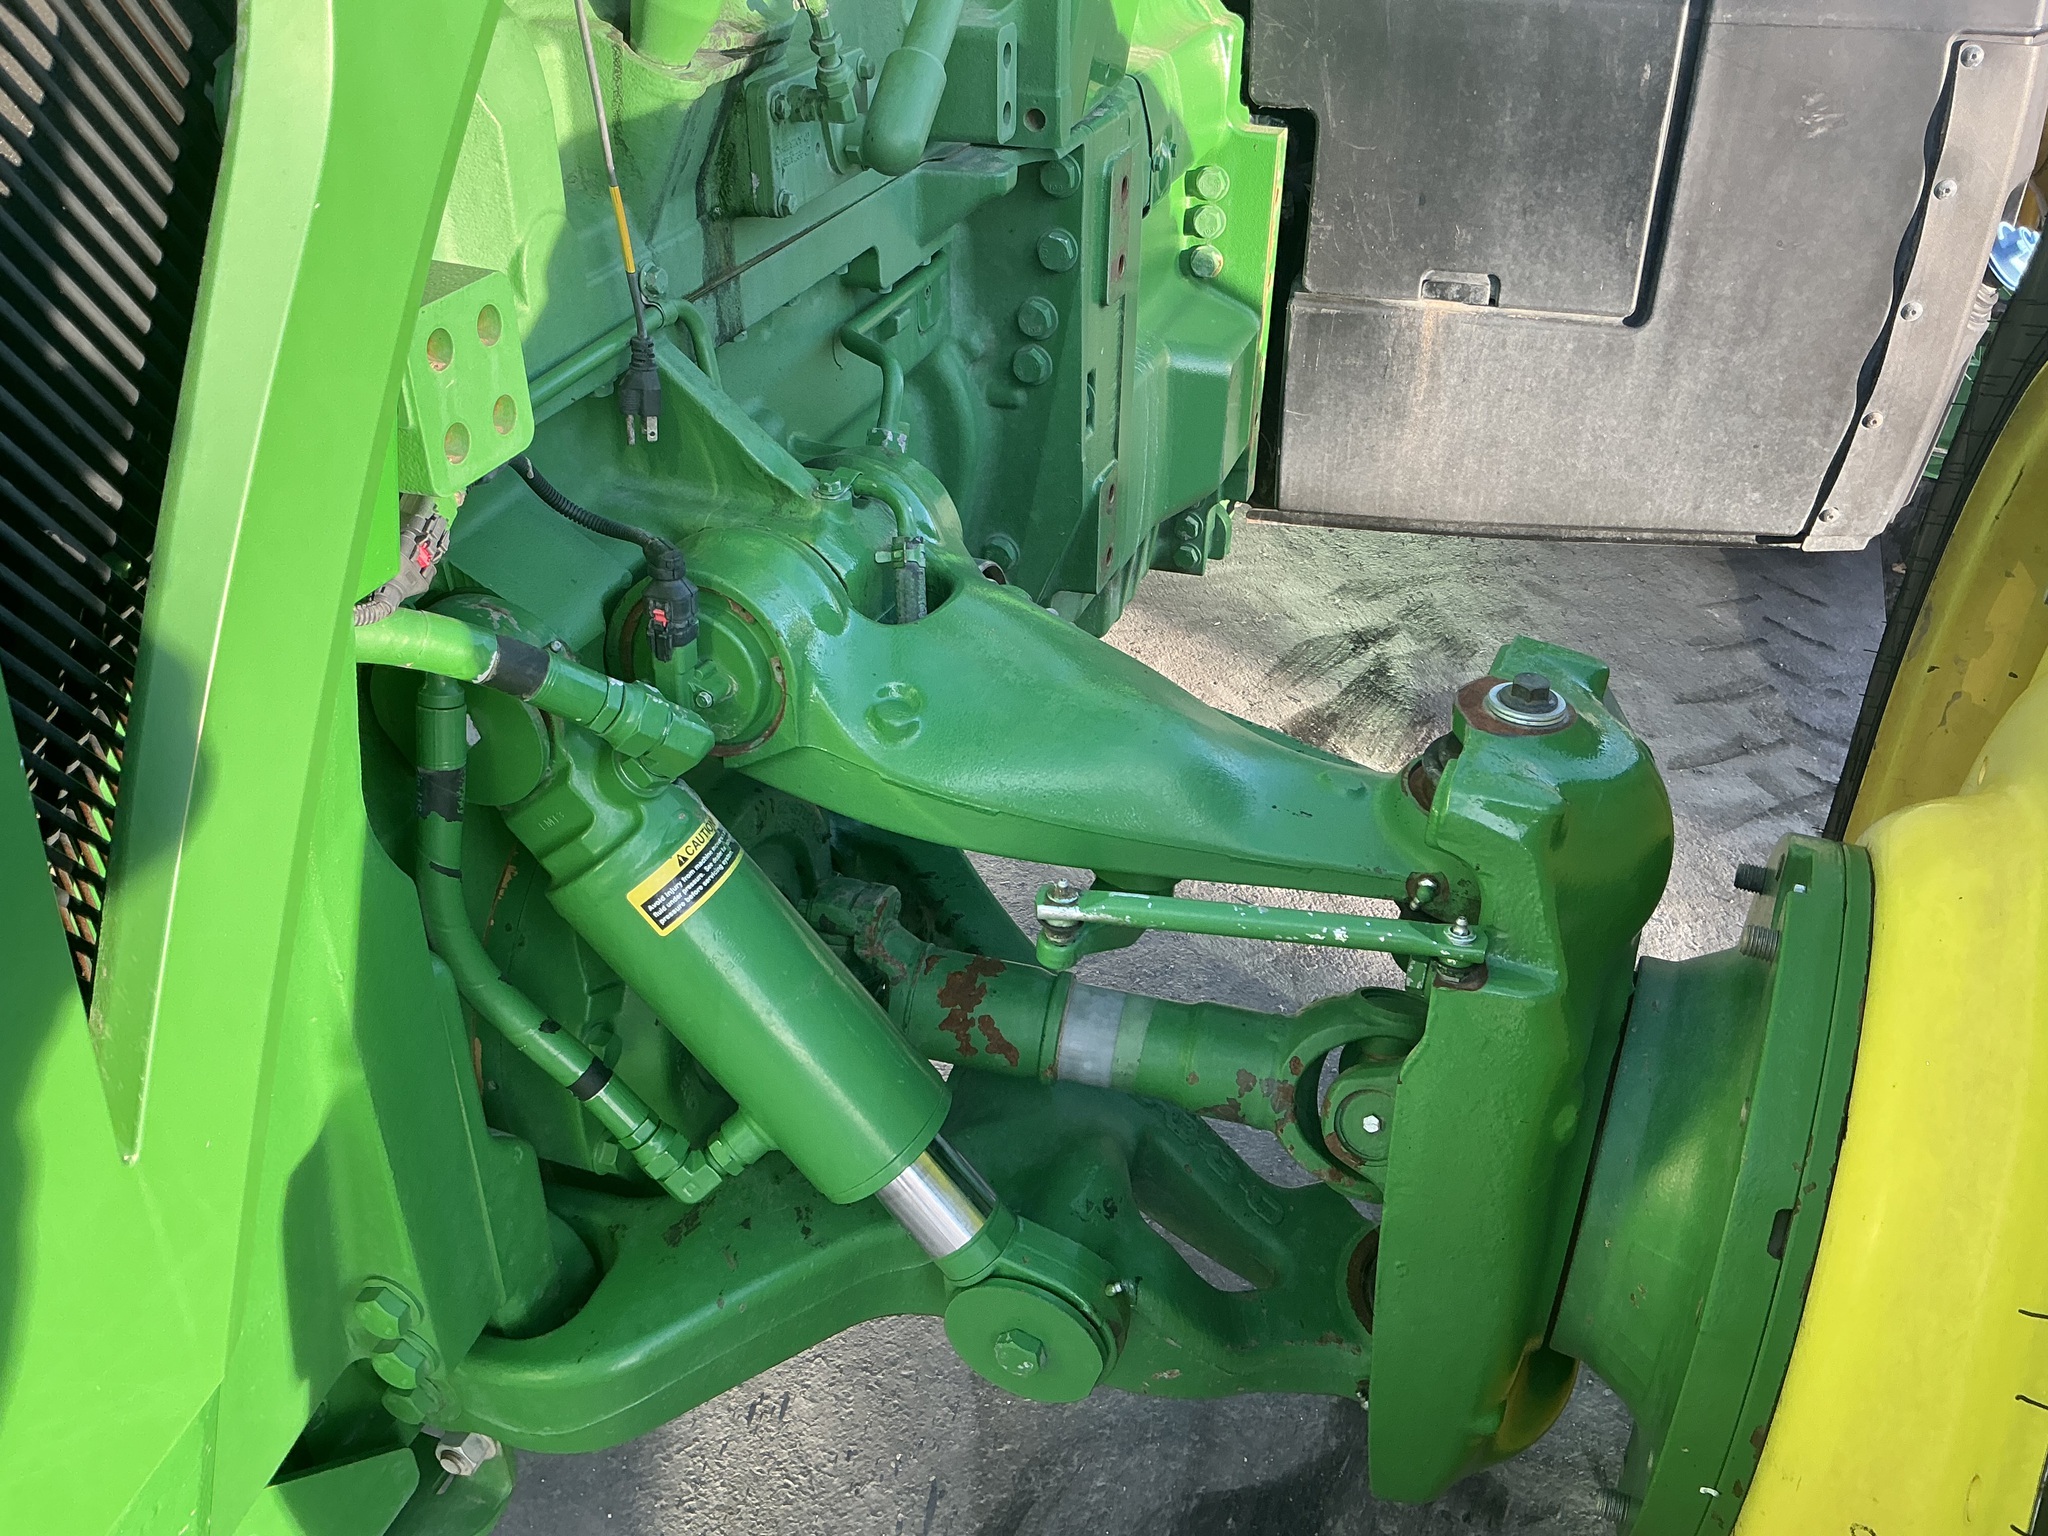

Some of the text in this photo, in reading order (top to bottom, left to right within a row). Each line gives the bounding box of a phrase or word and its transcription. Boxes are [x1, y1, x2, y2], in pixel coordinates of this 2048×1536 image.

[685, 817, 716, 856] CAUTION
[647, 850, 713, 912] Avoid injury from machine
[652, 905, 667, 918] fluid
[666, 892, 682, 907] under
[682, 873, 705, 895] pressure.
[704, 862, 714, 872] See
[659, 902, 686, 925] pressure
[684, 885, 703, 902] before
[702, 864, 724, 887] servicing
